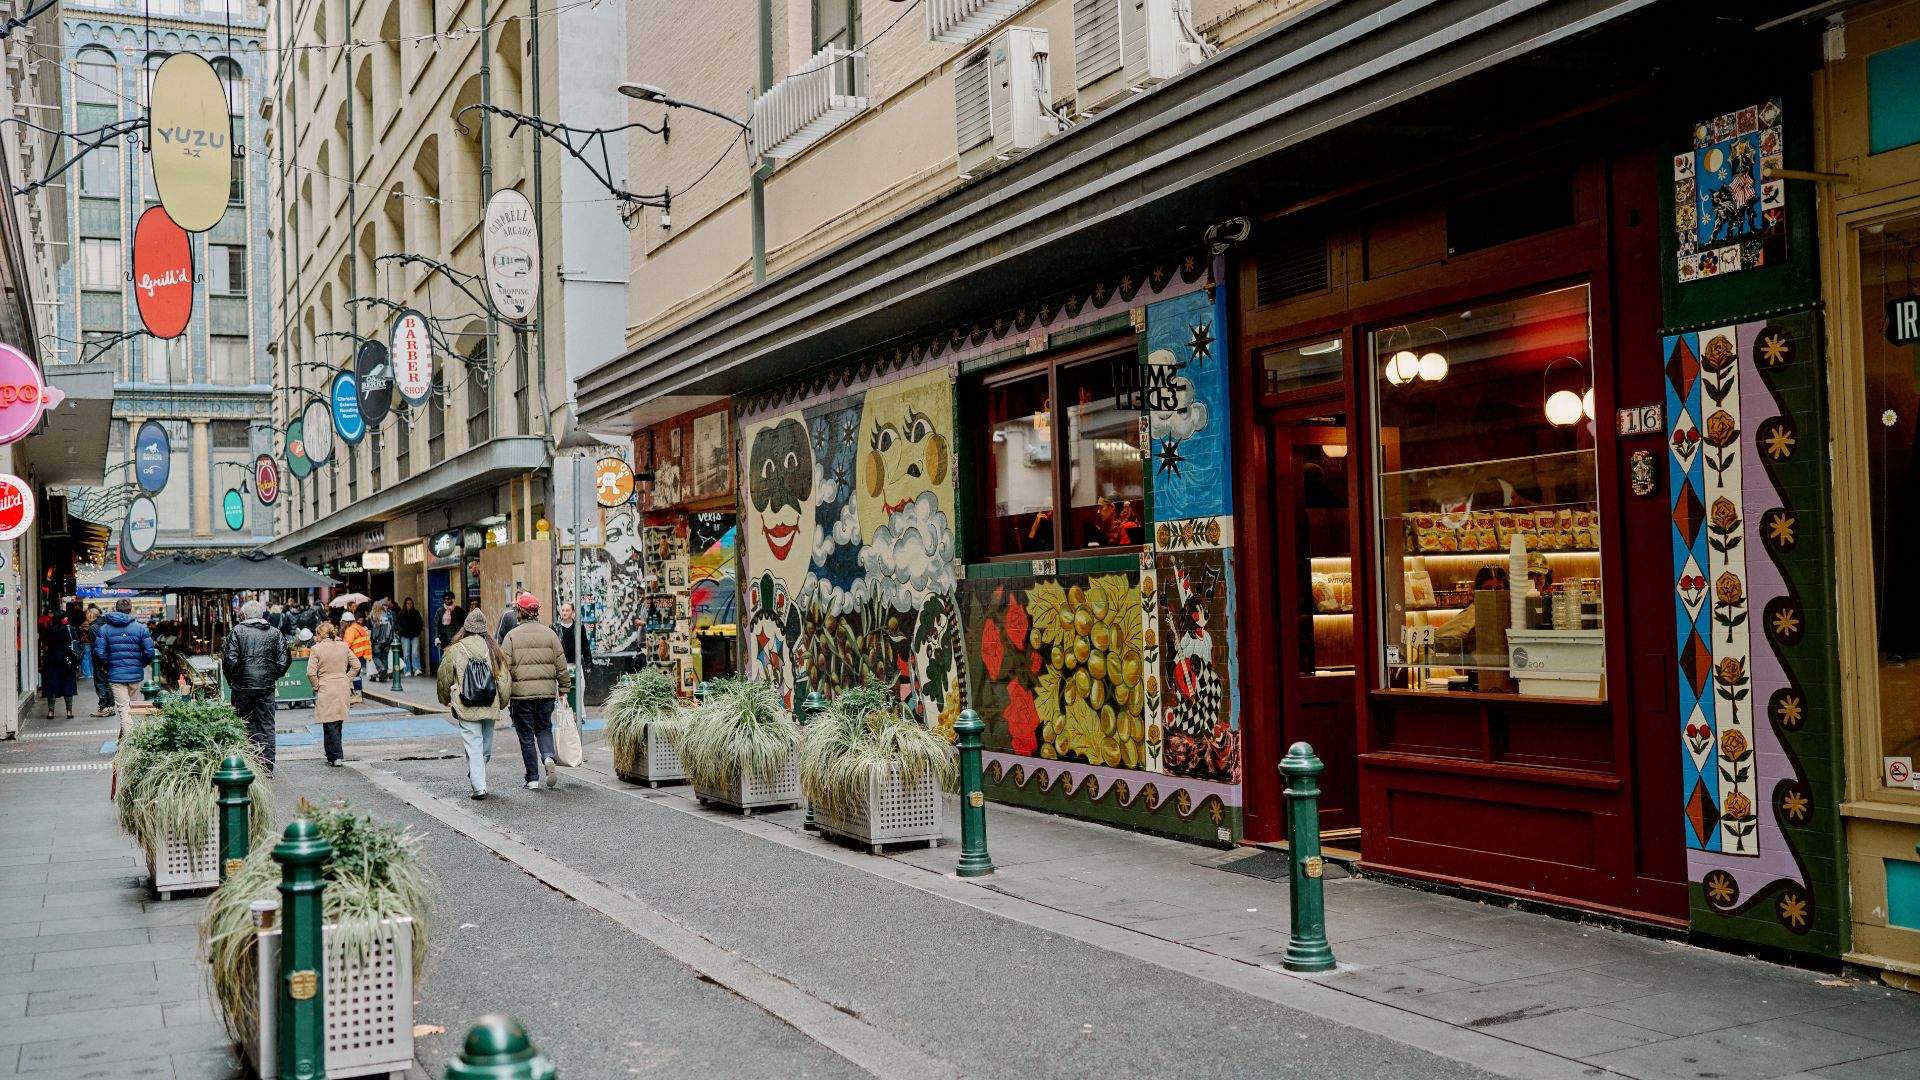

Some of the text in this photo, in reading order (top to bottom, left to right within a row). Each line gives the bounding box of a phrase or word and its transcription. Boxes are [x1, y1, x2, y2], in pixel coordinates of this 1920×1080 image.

[157, 126, 225, 149] YUZU
[488, 209, 528, 235] CAMPBELL
[503, 226, 532, 237] ARCADE
[138, 267, 191, 297] Grill'd
[499, 288, 529, 296] SHOPPING
[405, 318, 420, 382] BARBER
[404, 386, 425, 395] SHOP
[1626, 408, 1656, 430] 16
[1423, 629, 1430, 641] 2
